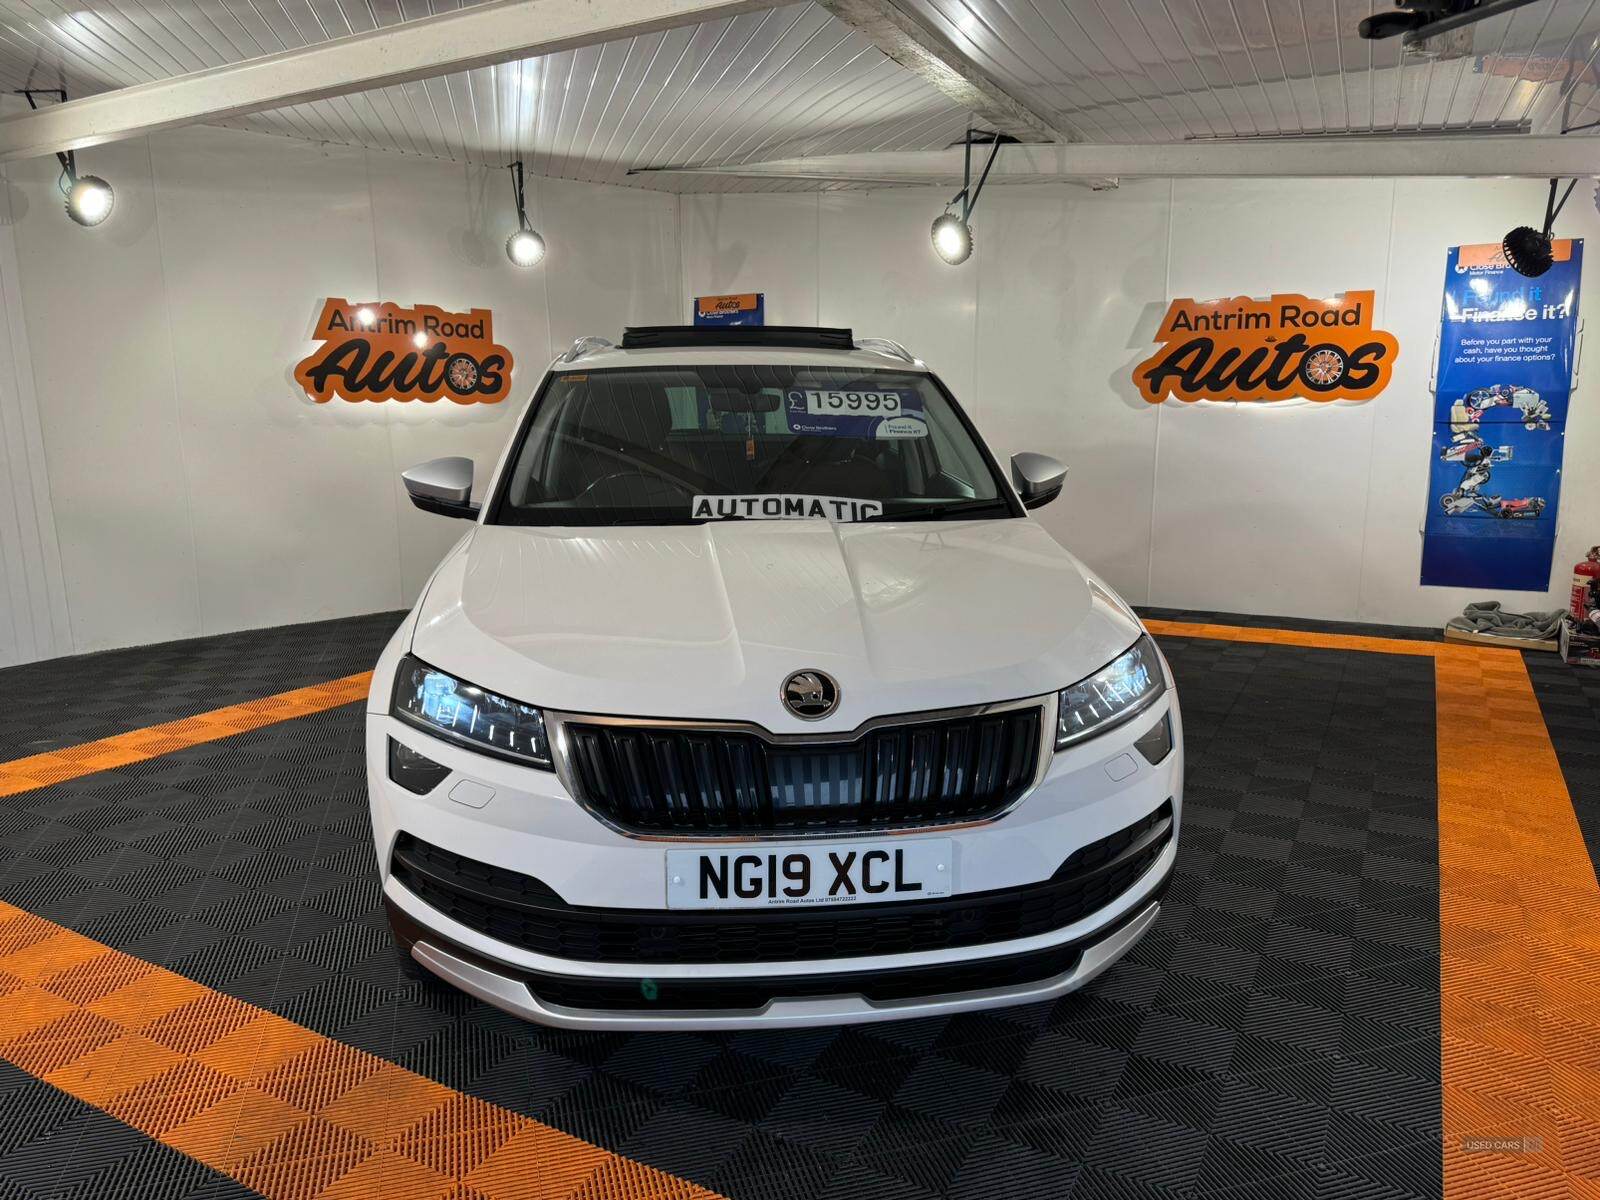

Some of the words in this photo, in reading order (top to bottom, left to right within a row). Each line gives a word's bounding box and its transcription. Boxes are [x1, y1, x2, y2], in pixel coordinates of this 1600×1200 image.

[1529, 285, 1542, 301] it
[714, 300, 741, 310] Autos
[1542, 303, 1566, 320] it?
[1169, 307, 1271, 333] Antrim
[1279, 302, 1362, 329] Road
[423, 315, 485, 340] Road
[1461, 338, 1485, 346] Before
[1486, 338, 1500, 347] you
[1501, 337, 1516, 346] part
[1518, 336, 1534, 344] with
[1535, 336, 1552, 344] your
[1484, 347, 1503, 355] have
[1504, 347, 1518, 355] you
[1519, 345, 1548, 354] thought
[305, 338, 506, 396] Autos
[1142, 333, 1388, 395] Autos
[1454, 355, 1476, 364] about
[1477, 355, 1493, 364] your
[1494, 354, 1522, 362] finance
[1523, 353, 1556, 362] options?
[810, 392, 898, 411] 15995
[694, 498, 878, 521] AUTOMATIC
[699, 852, 812, 900] NG19
[827, 848, 923, 897] XCL
